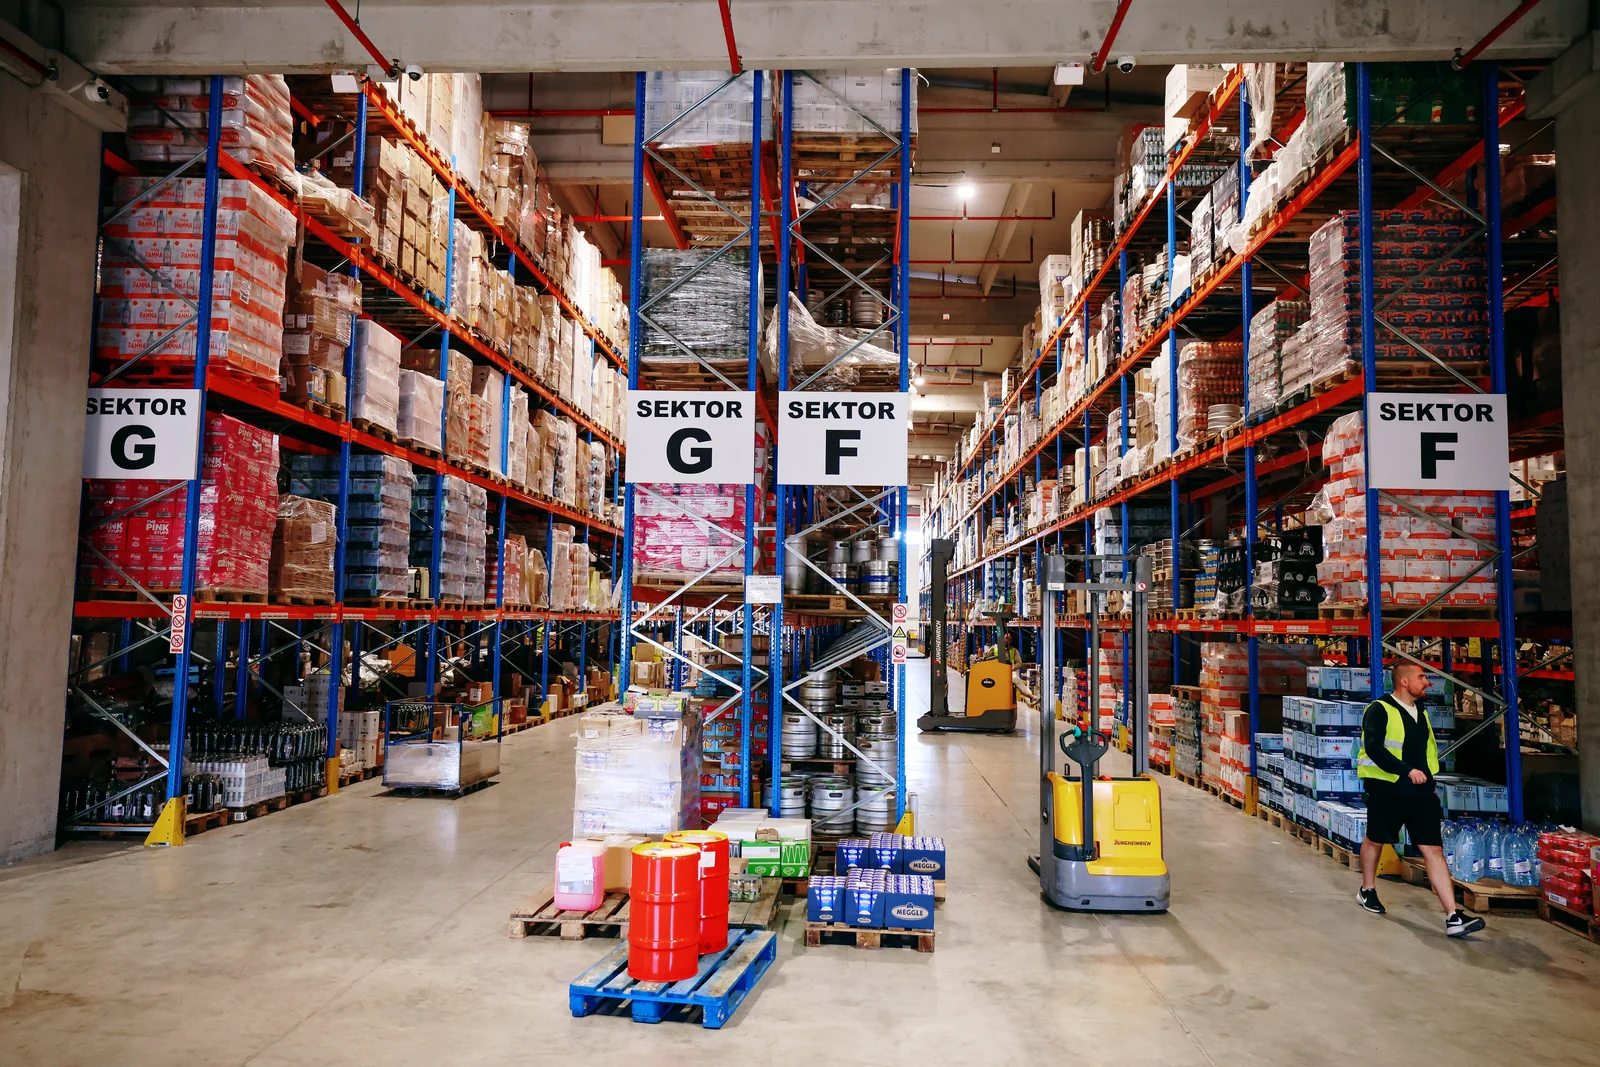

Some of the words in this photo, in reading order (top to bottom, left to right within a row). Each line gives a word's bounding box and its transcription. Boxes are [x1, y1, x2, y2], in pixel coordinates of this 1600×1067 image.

[86, 398, 187, 416] SEKTOR
[637, 400, 743, 418] SEKTOR
[788, 401, 896, 420] SEKTOR
[1380, 402, 1495, 422] SEKTOR
[110, 425, 157, 470] G
[666, 427, 713, 474] G
[825, 429, 861, 475] F
[1420, 432, 1458, 480] F
[146, 523, 169, 531] PINK
[912, 862, 937, 870] MEGGLE
[896, 909, 924, 917] MEGGLE
